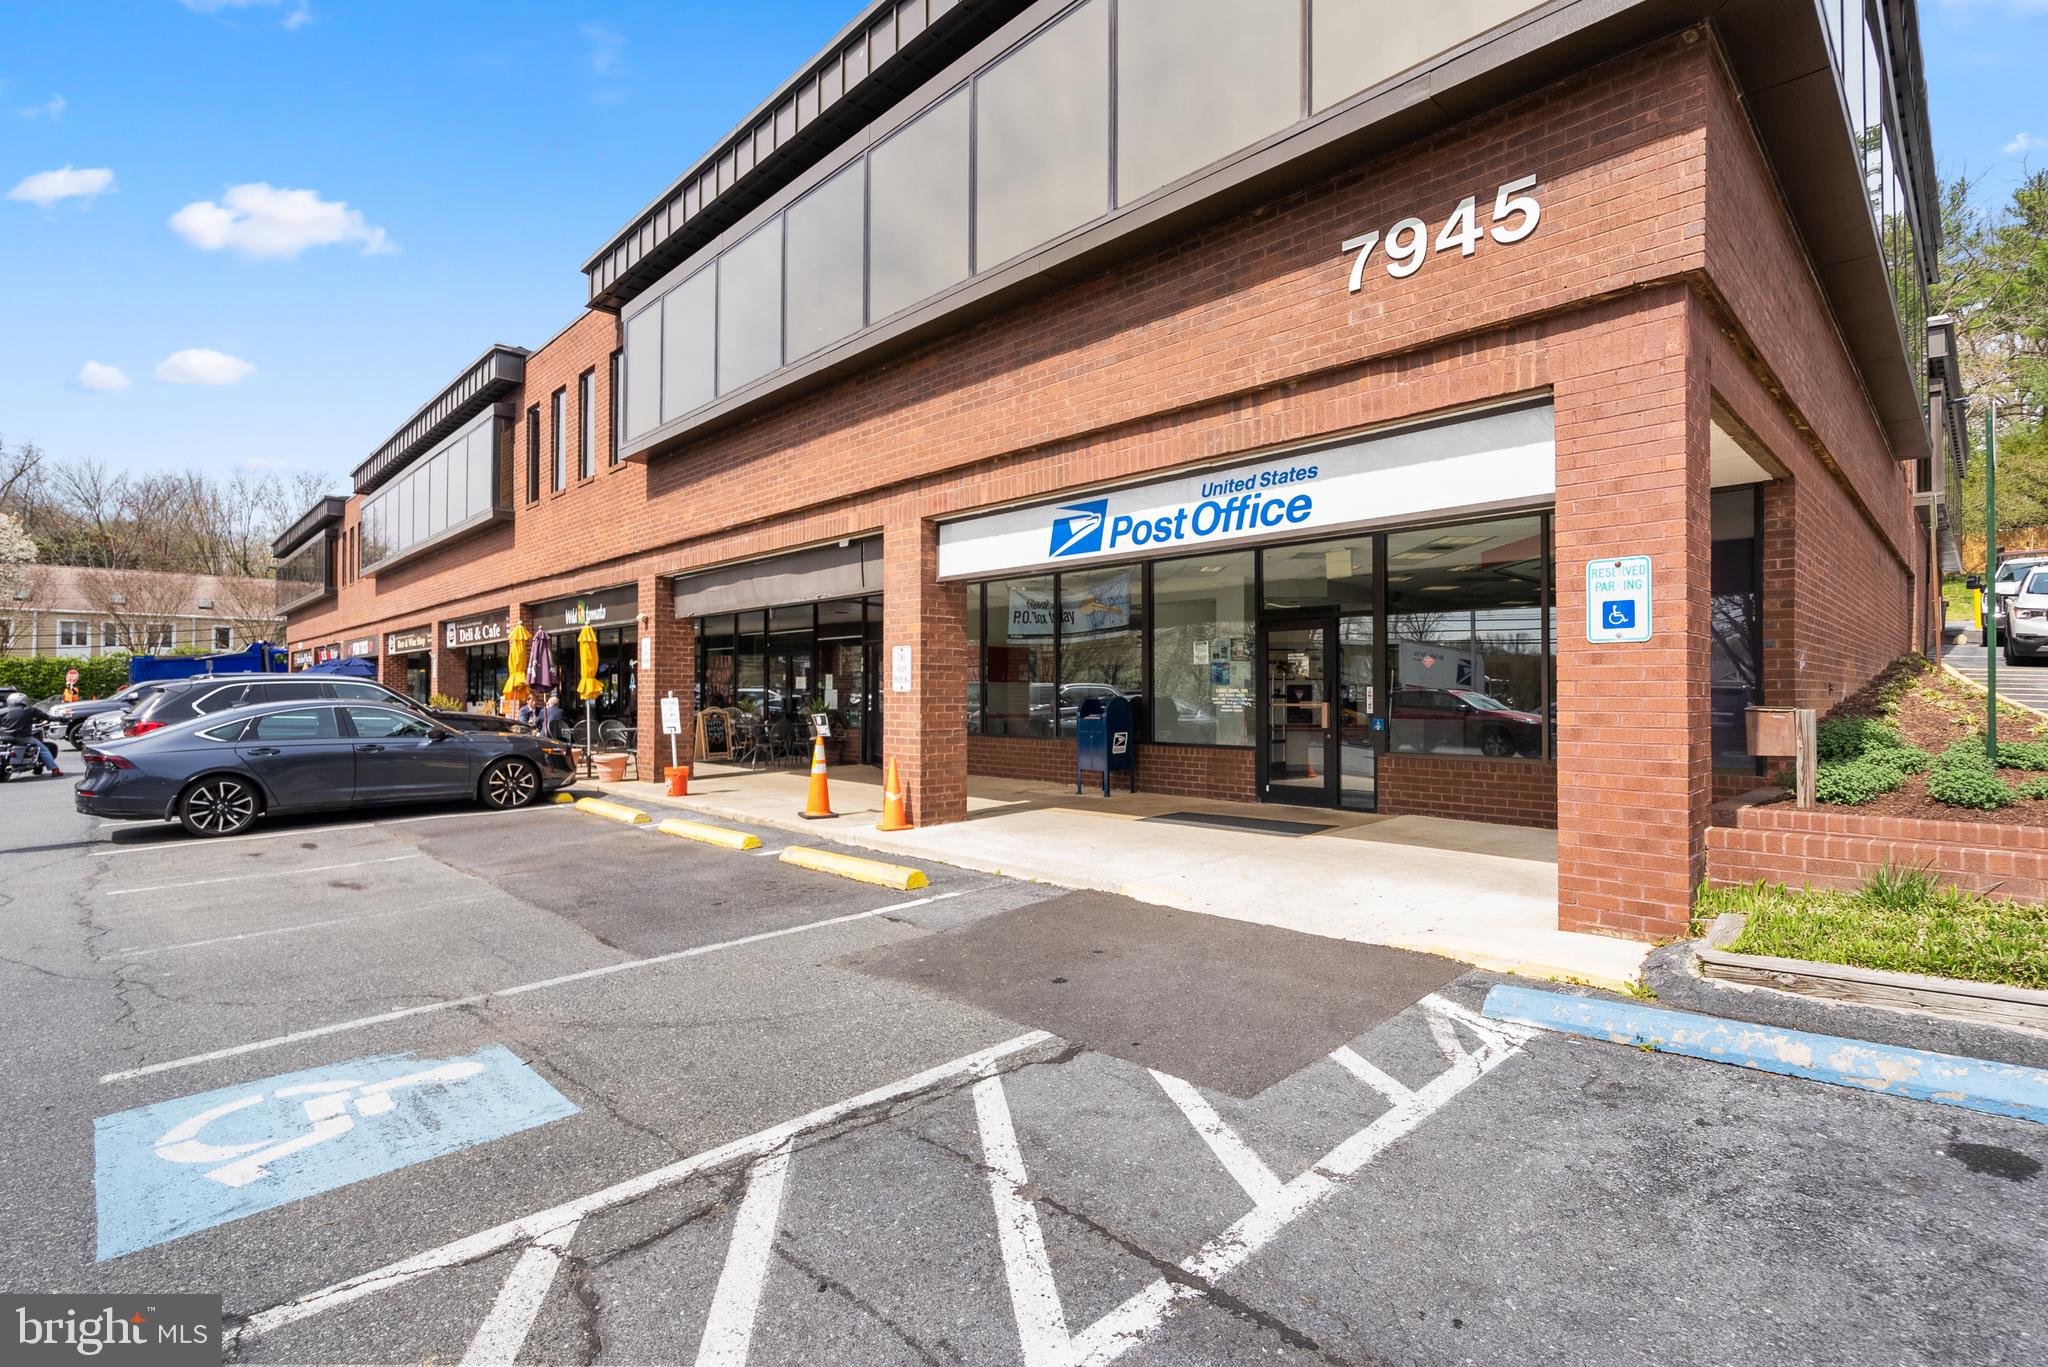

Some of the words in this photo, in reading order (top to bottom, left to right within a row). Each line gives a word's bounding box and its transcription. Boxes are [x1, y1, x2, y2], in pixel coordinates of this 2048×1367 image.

[1342, 174, 1541, 292] 7945
[1202, 475, 1256, 498] United
[1260, 465, 1319, 487] States
[1110, 508, 1188, 549] Post
[1192, 493, 1313, 536] Office
[1595, 580, 1643, 592] PARING
[1013, 610, 1032, 624] P.O.
[1049, 610, 1075, 625] tay
[459, 629, 473, 642] Deli
[474, 626, 481, 639] &
[482, 623, 501, 639] Cafe
